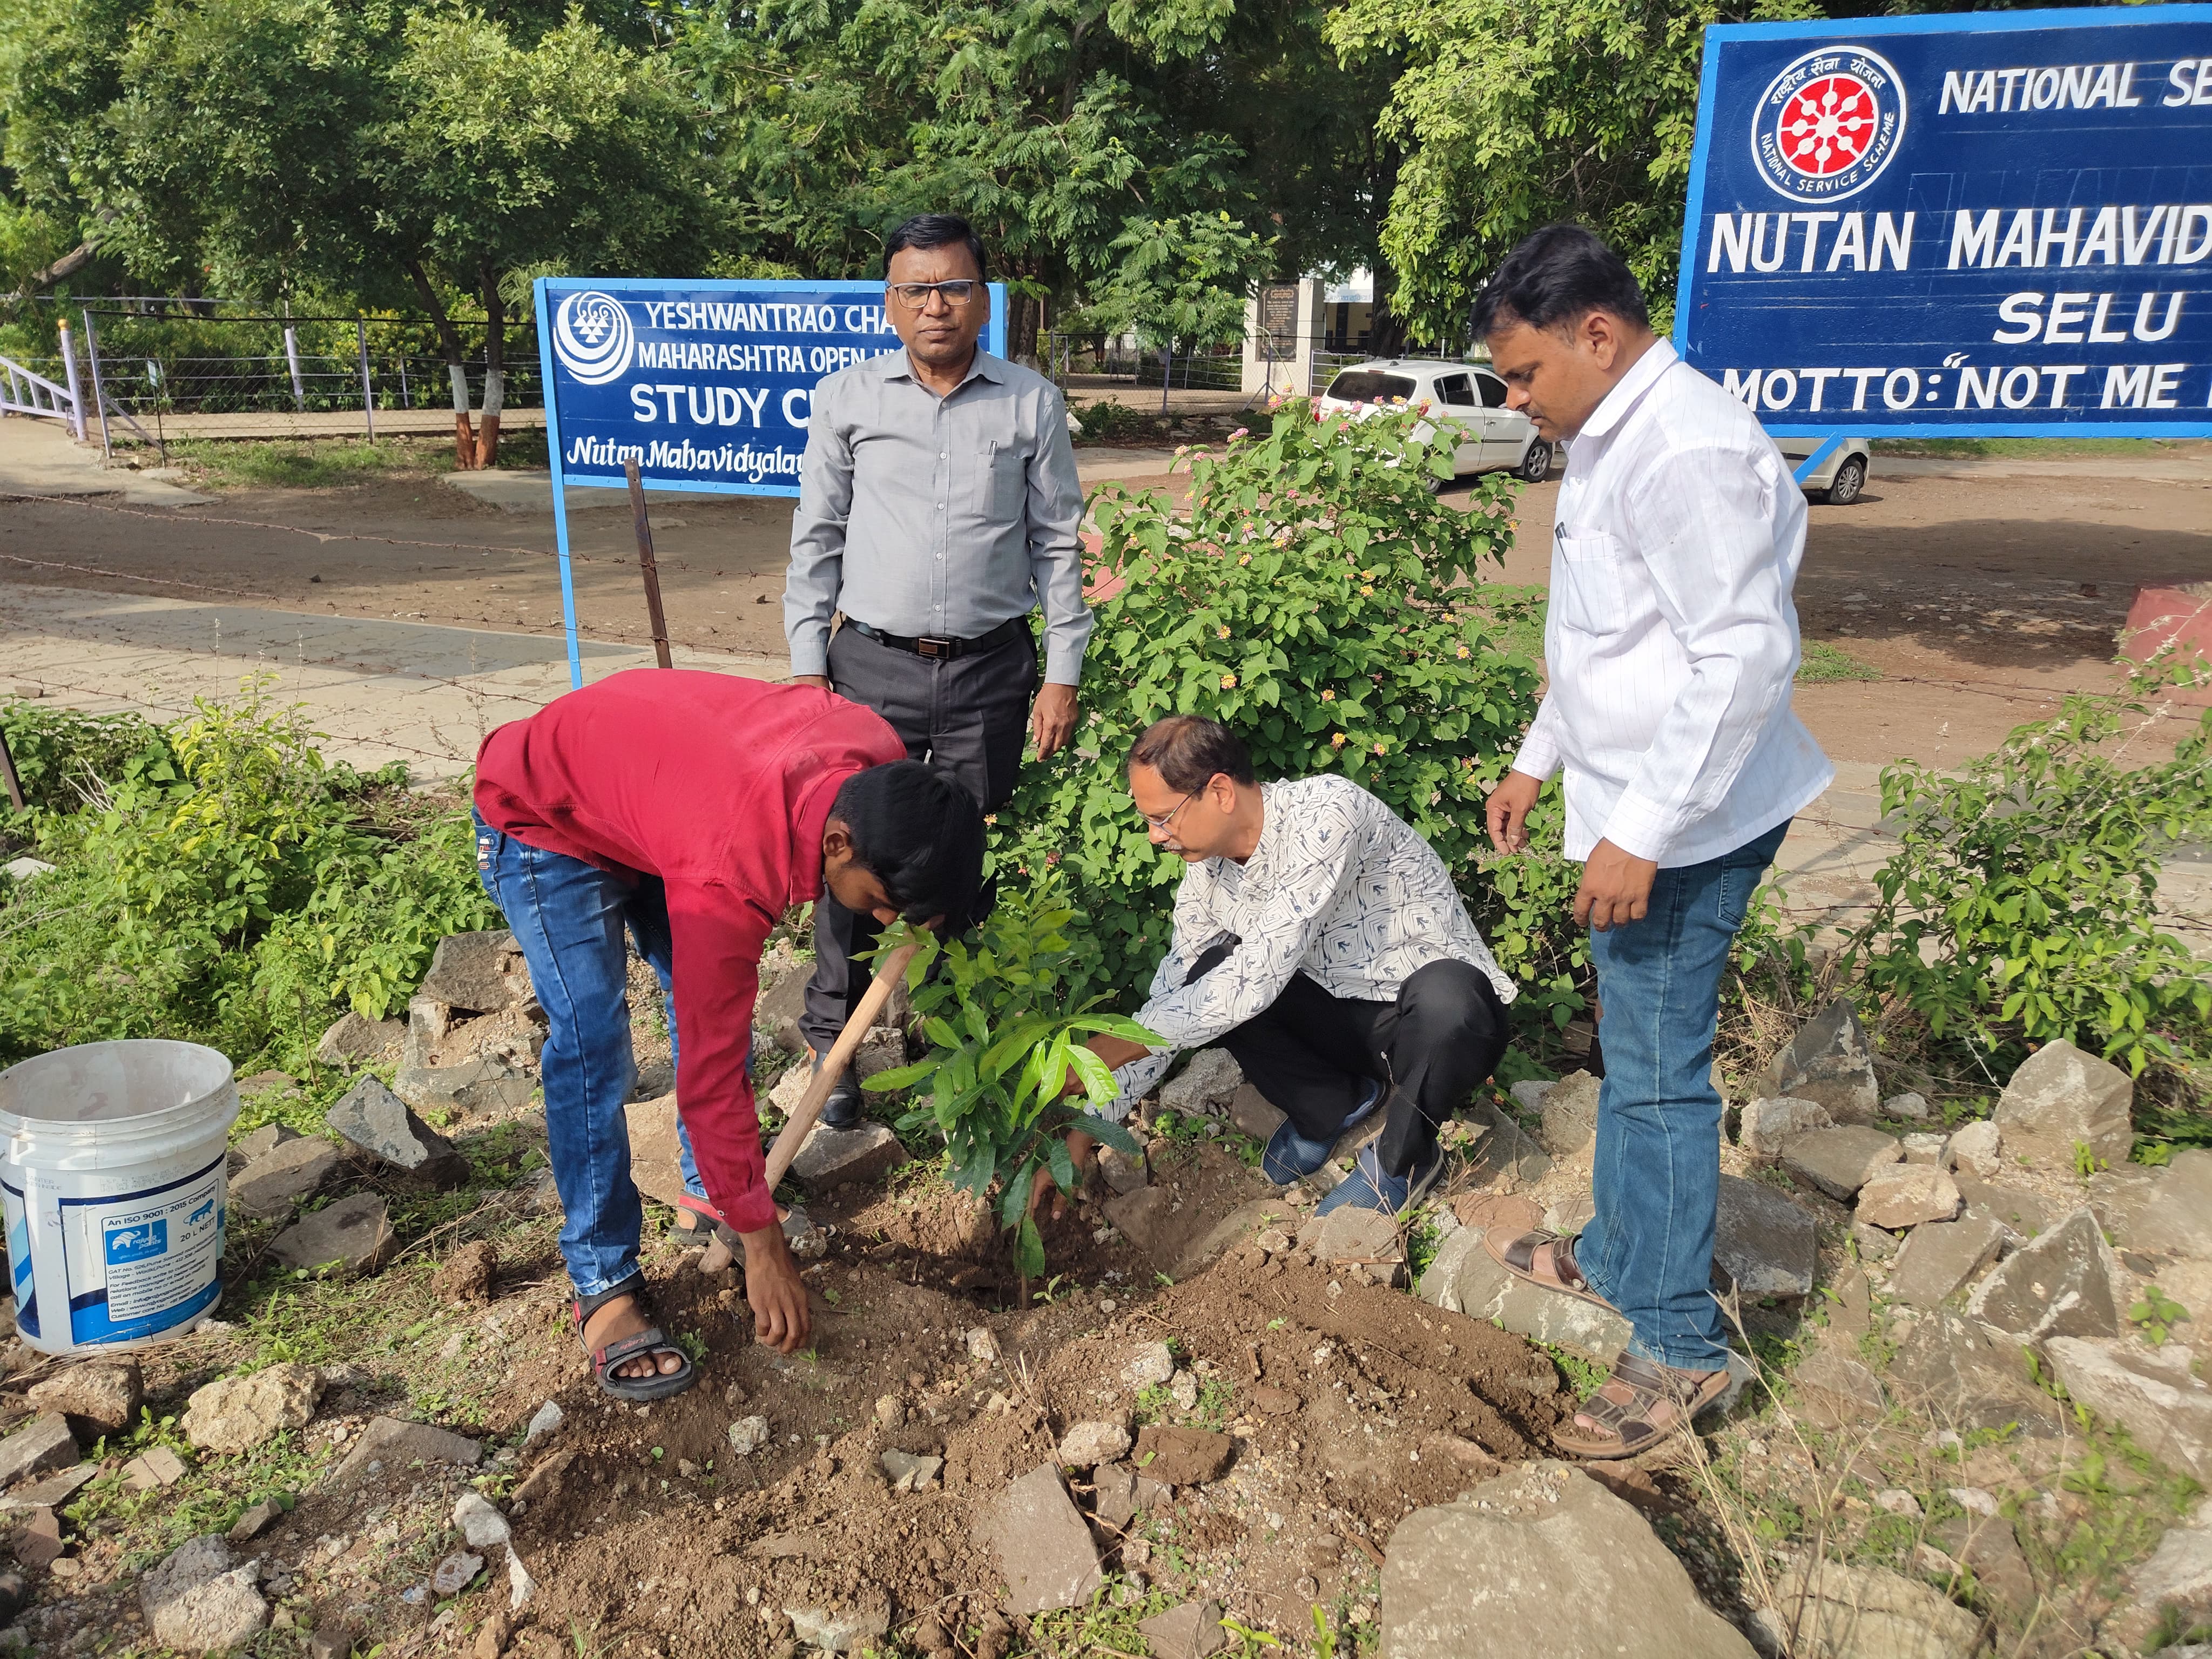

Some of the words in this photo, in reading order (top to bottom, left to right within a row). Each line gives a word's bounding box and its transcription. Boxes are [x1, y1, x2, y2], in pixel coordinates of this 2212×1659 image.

[1811, 57, 1840, 75] सेवा
[1850, 58, 1886, 89] योजना
[1939, 63, 2140, 114] NATIONAL
[1761, 132, 1791, 186] NATIONAL
[1797, 170, 1858, 192] SERVICE
[1864, 112, 1894, 172] SCHEME
[1708, 211, 1914, 273] NUTAN
[1947, 205, 2212, 270] MAHAVID
[645, 302, 836, 333] YESHWANTRAO
[1993, 292, 2184, 344] SELU
[638, 343, 806, 373] MAHARASHTRA
[810, 347, 865, 373] OPEN
[1723, 367, 1941, 412] MOTTO:
[2101, 364, 2186, 409] ME
[630, 384, 769, 427] STUDY
[567, 436, 643, 468] Nutan
[124, 1216, 140, 1224] ISO
[143, 1209, 164, 1220] 9001
[170, 1202, 187, 1212] 2015
[188, 1185, 216, 1205] Company
[180, 1232, 191, 1243] 20
[199, 1216, 216, 1232] NETT
[110, 1286, 138, 1294] relations
[138, 1278, 166, 1289] manager
[121, 1276, 152, 1286] Feedback
[132, 1287, 153, 1296] mobile
[111, 1310, 141, 1319] Customer
